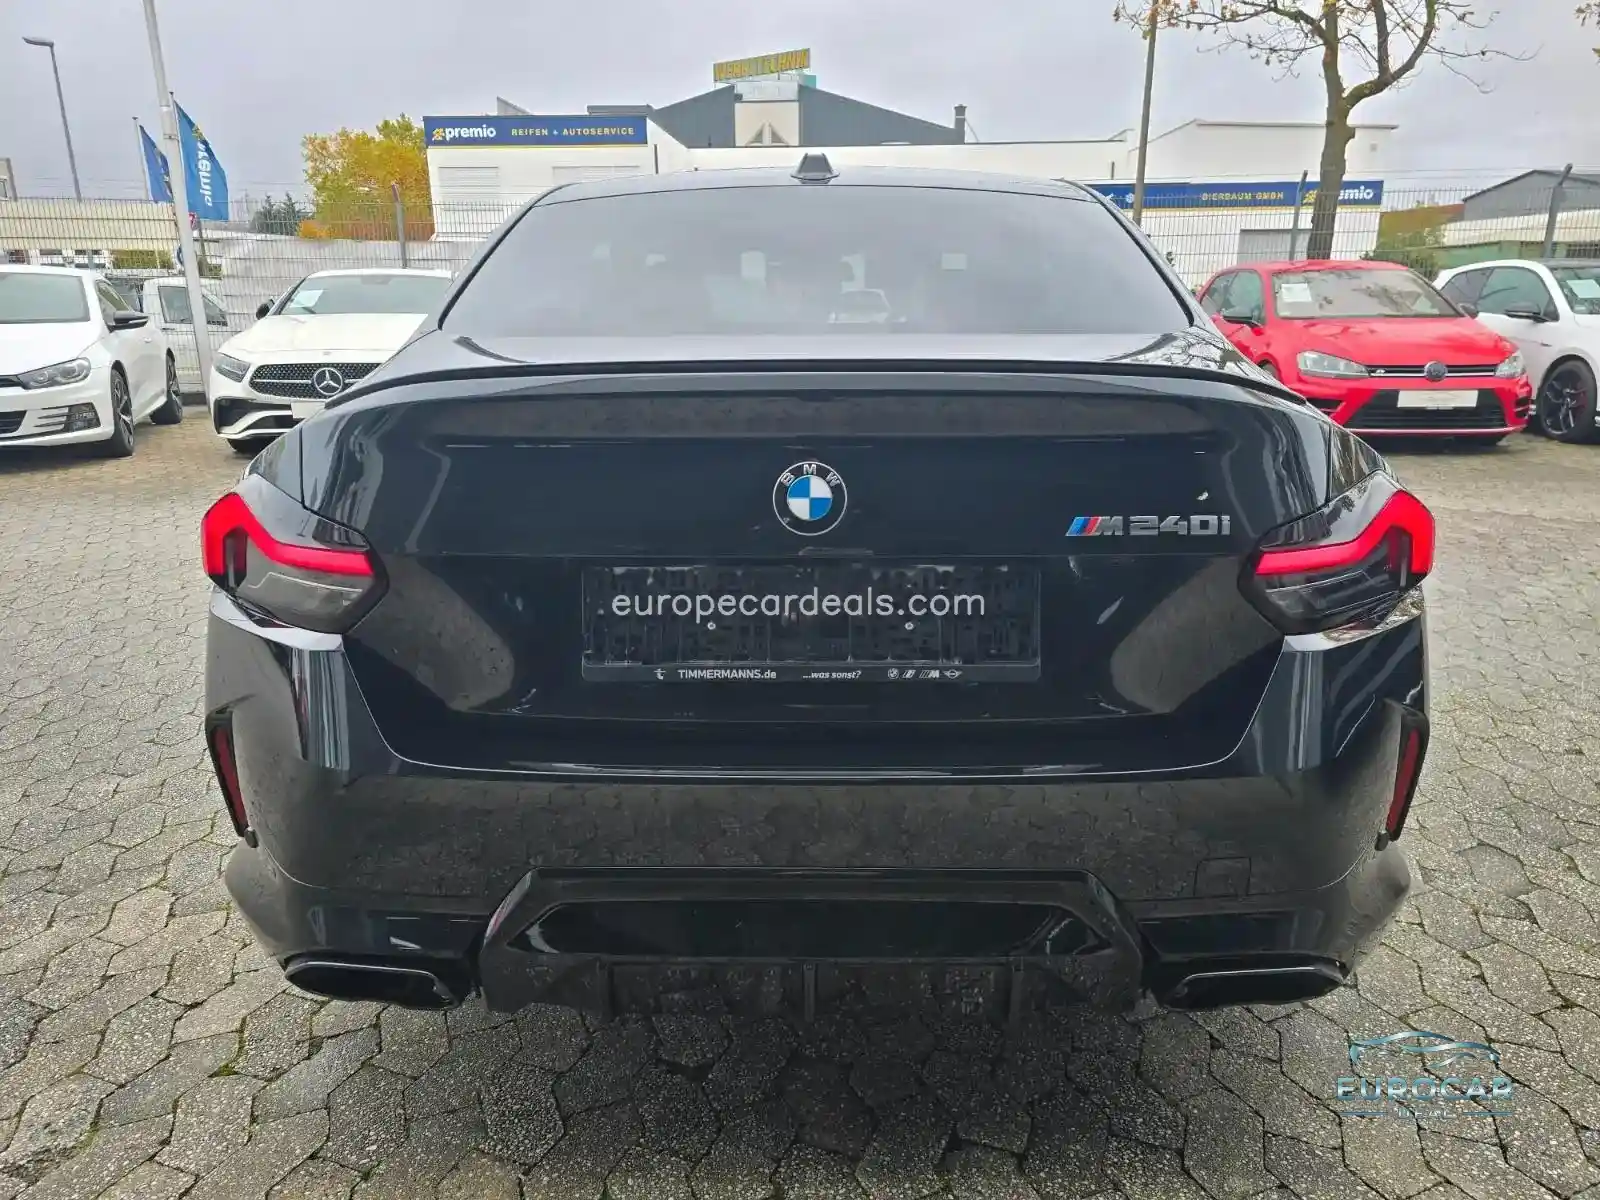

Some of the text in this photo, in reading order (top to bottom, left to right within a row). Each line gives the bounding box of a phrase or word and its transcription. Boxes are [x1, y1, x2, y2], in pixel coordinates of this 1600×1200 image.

[445, 124, 497, 141] premio
[511, 128, 548, 136] REIFEN
[563, 127, 634, 136] AUTOSERVICE
[781, 464, 840, 486] BMW
[677, 669, 777, 679] TIMMERMANNS.de
[831, 670, 861, 679] sonst?
